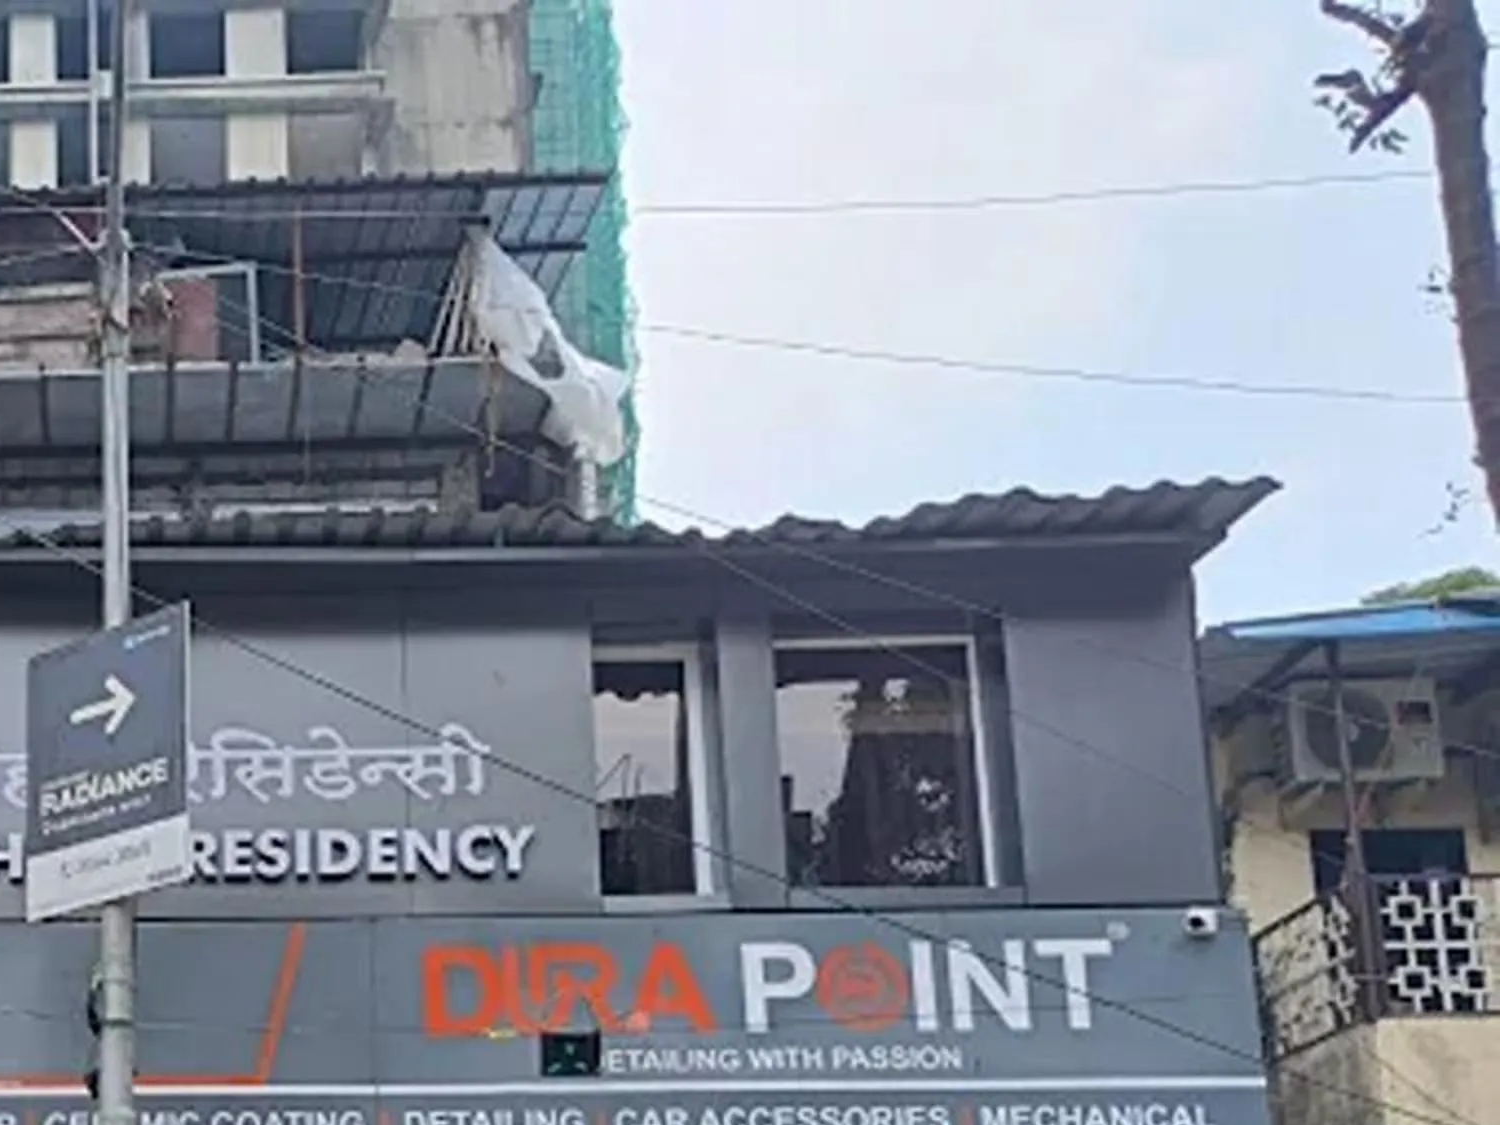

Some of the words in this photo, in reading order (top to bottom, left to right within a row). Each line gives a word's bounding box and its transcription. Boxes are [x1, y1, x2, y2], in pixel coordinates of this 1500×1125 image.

[38, 755, 169, 818] RADIANCE
[185, 824, 536, 886] RESIDENCY
[421, 939, 721, 1039] DURA
[739, 937, 1113, 1035] POINT
[599, 1047, 742, 1074] ETAILING
[746, 1047, 823, 1070] WITH
[831, 1044, 963, 1069] PASSION
